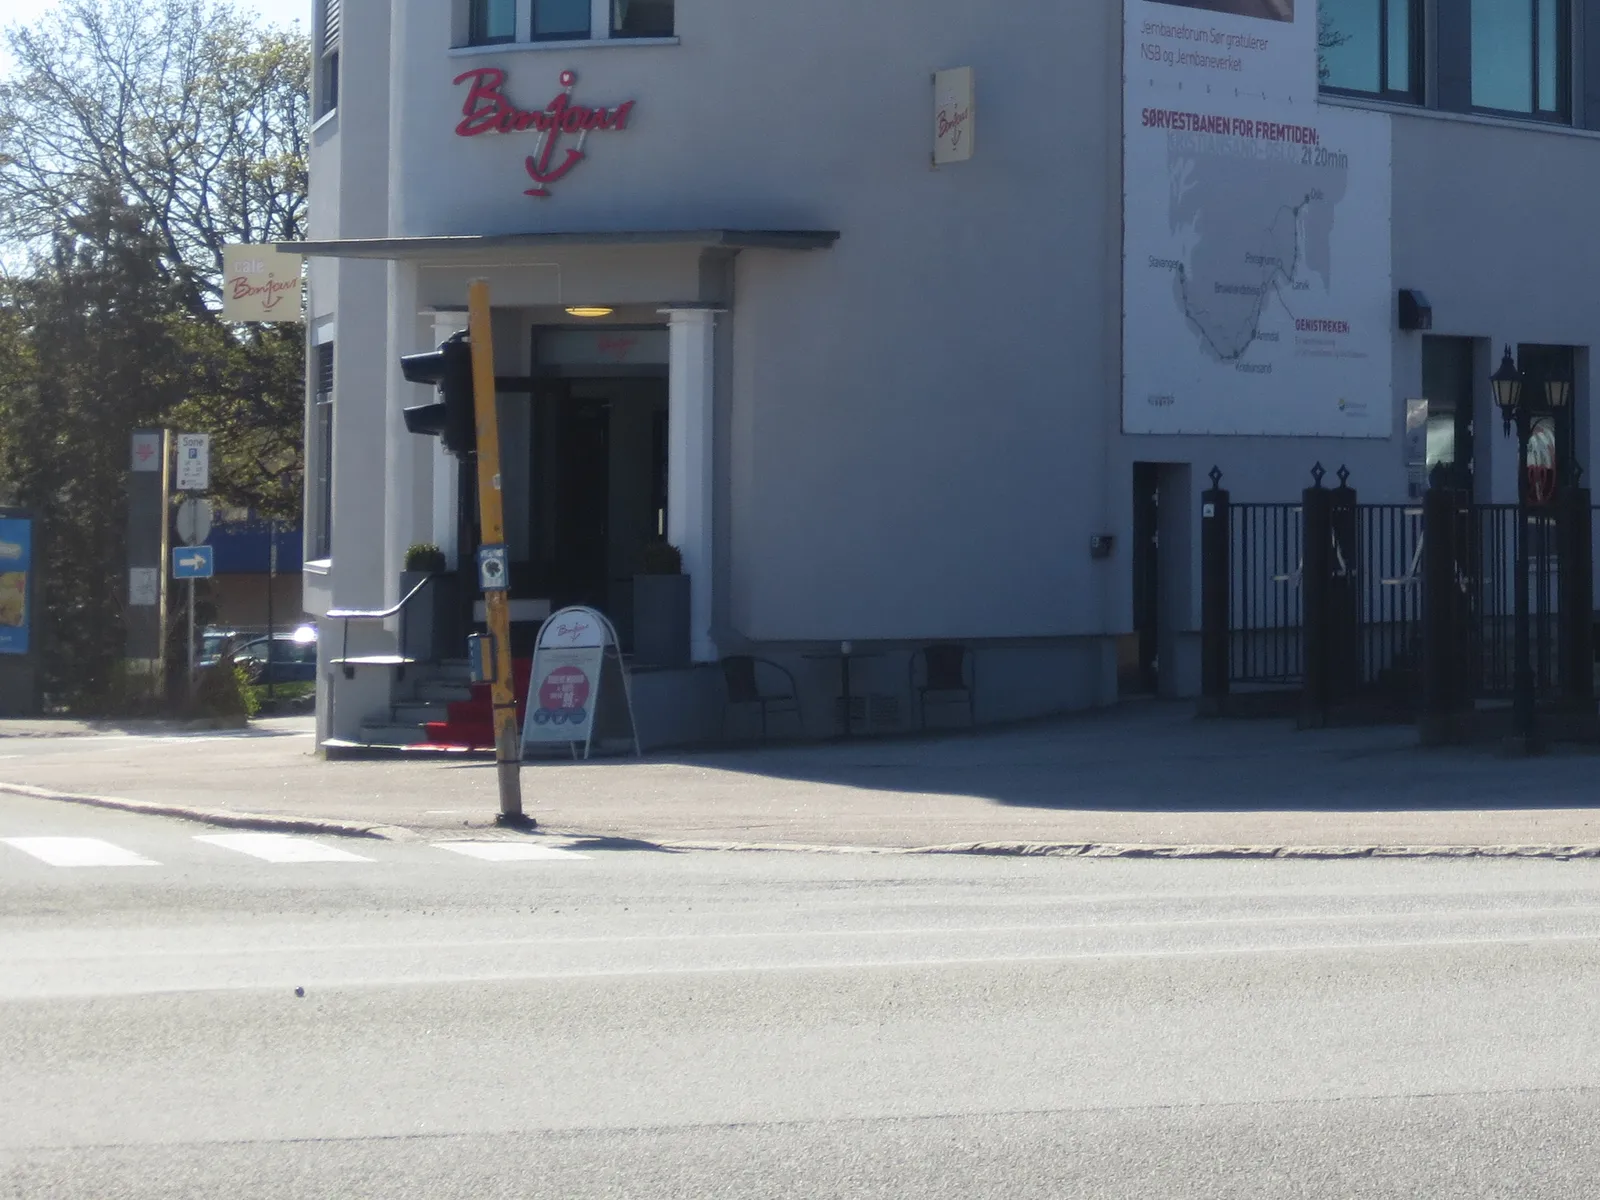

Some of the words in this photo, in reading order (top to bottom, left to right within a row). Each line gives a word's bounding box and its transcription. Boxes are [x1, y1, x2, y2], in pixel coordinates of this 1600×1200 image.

[1140, 20, 1208, 42] Jernbaneforum
[1209, 28, 1224, 45] Sør
[1226, 33, 1269, 51] gratulerer
[1140, 42, 1161, 61] NSB
[1163, 49, 1174, 67] og
[1176, 48, 1242, 72] Jernbaneverket
[452, 67, 636, 183] Bonjour
[1142, 107, 1230, 134] SØRVESTBANEN
[1232, 118, 1254, 138] FOR
[1255, 120, 1320, 145] FREMTIDEN:
[1315, 146, 1348, 169] 20min
[1149, 254, 1179, 269] Stavanger
[229, 272, 298, 309] Bonjour
